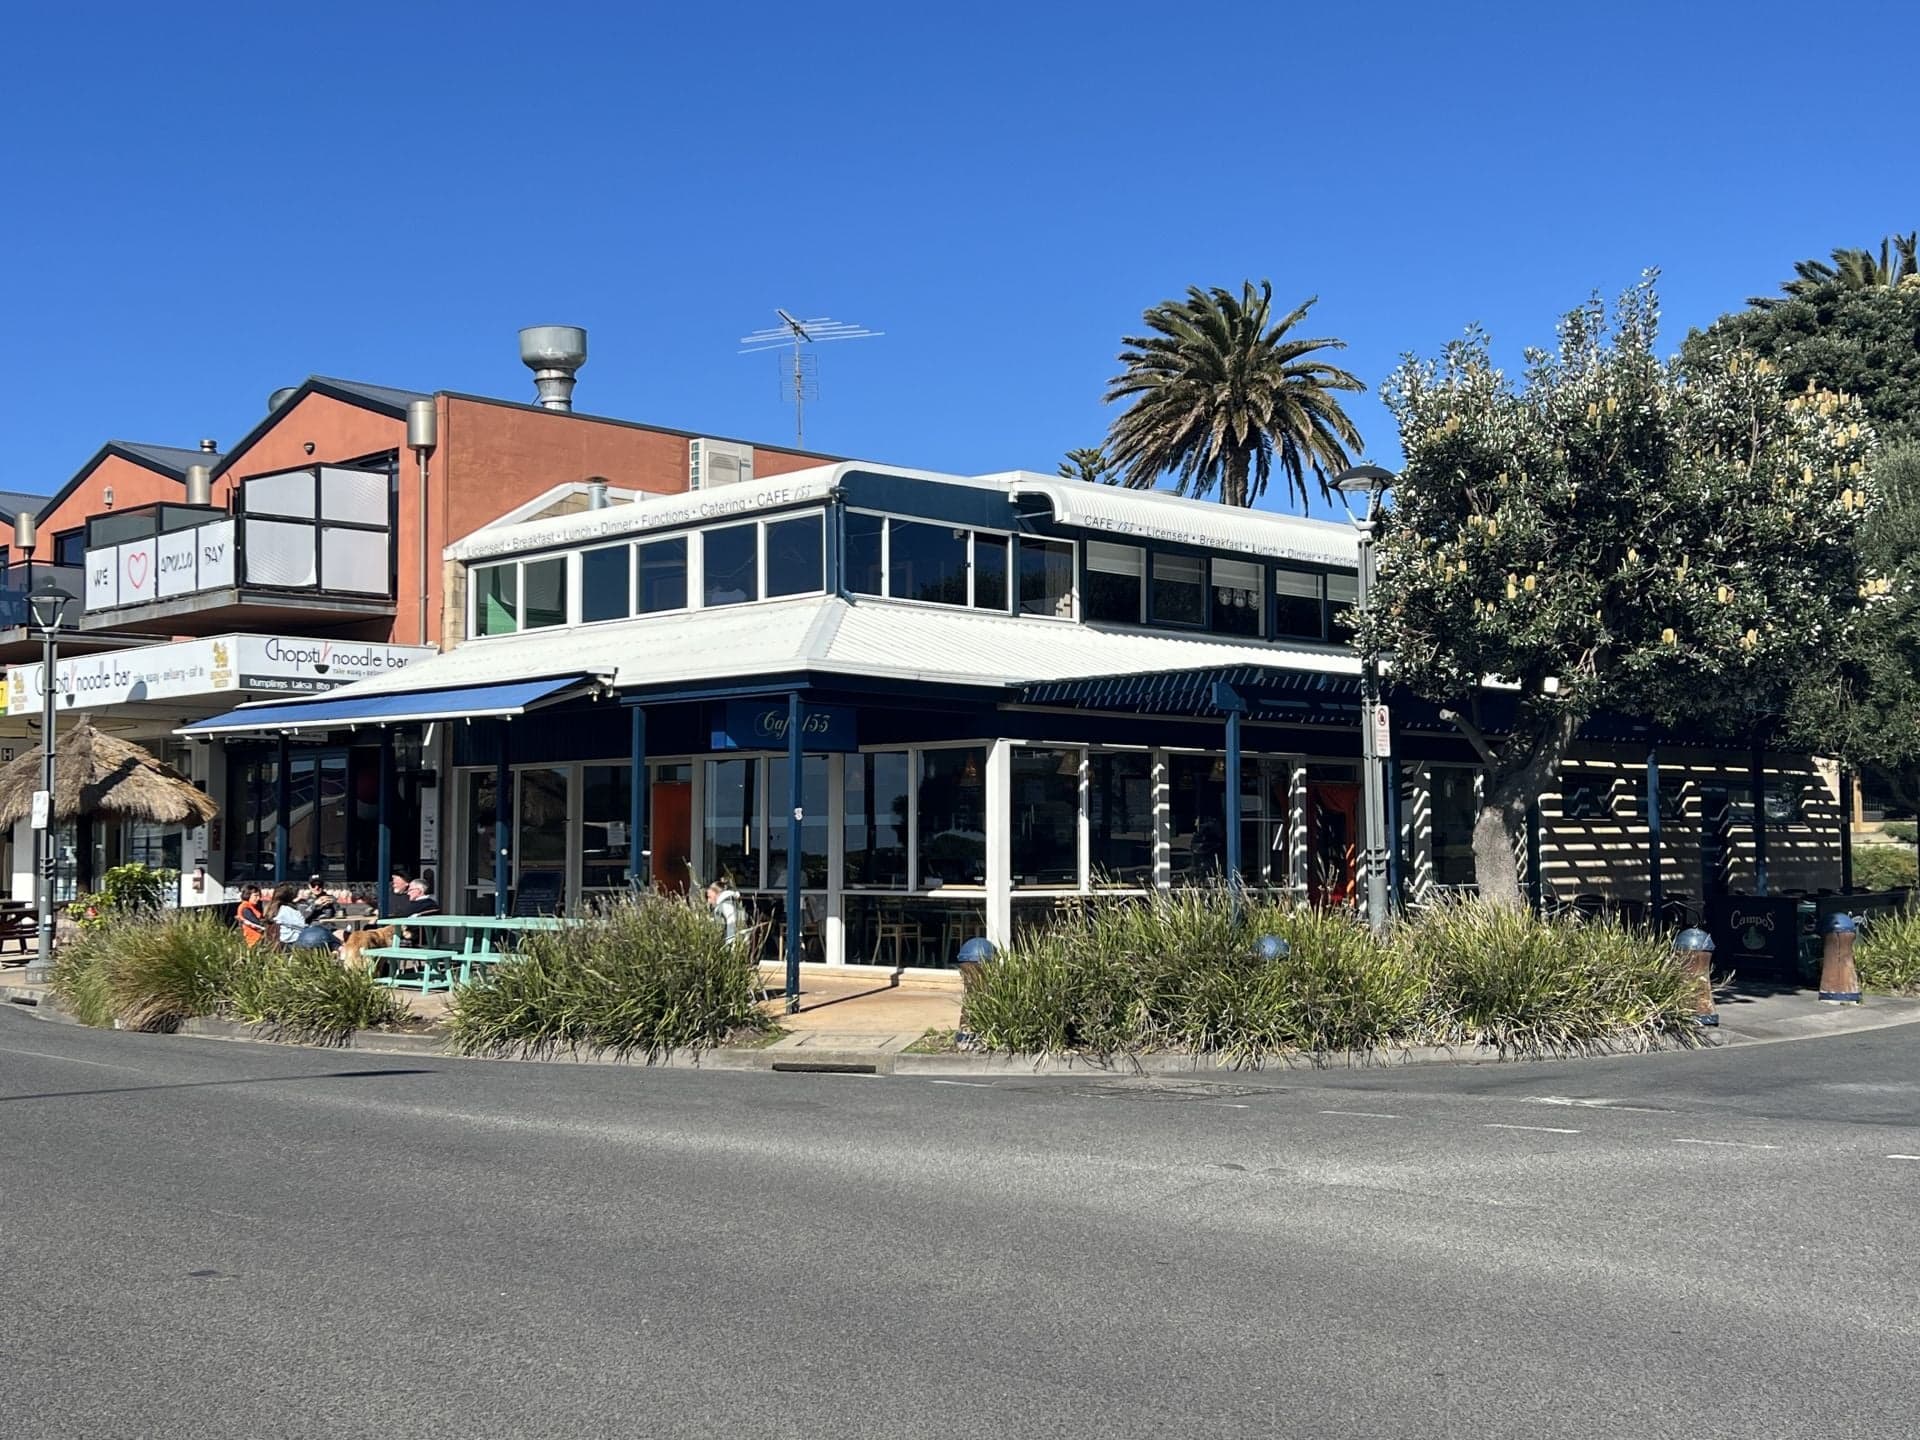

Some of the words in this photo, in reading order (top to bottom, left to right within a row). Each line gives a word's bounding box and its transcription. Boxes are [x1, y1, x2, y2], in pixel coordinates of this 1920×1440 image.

[601, 519, 632, 535] Dinner
[642, 509, 690, 526] Functions
[700, 498, 746, 516] Catering
[757, 488, 789, 506] CAFE
[1085, 515, 1112, 529] CAFE
[1146, 527, 1189, 542] Licensed
[1199, 534, 1242, 548] Breakfast
[1252, 543, 1277, 556] Lunch
[1288, 548, 1315, 561] Dinner
[204, 544, 225, 564] BAY
[332, 648, 382, 666] noodle
[387, 648, 409, 668] bar
[77, 660, 111, 691] noodle
[114, 659, 131, 687] bar
[249, 678, 288, 689] Dumplings
[292, 681, 313, 689] Laksa
[757, 710, 790, 740] Caf
[802, 713, 831, 732] 155
